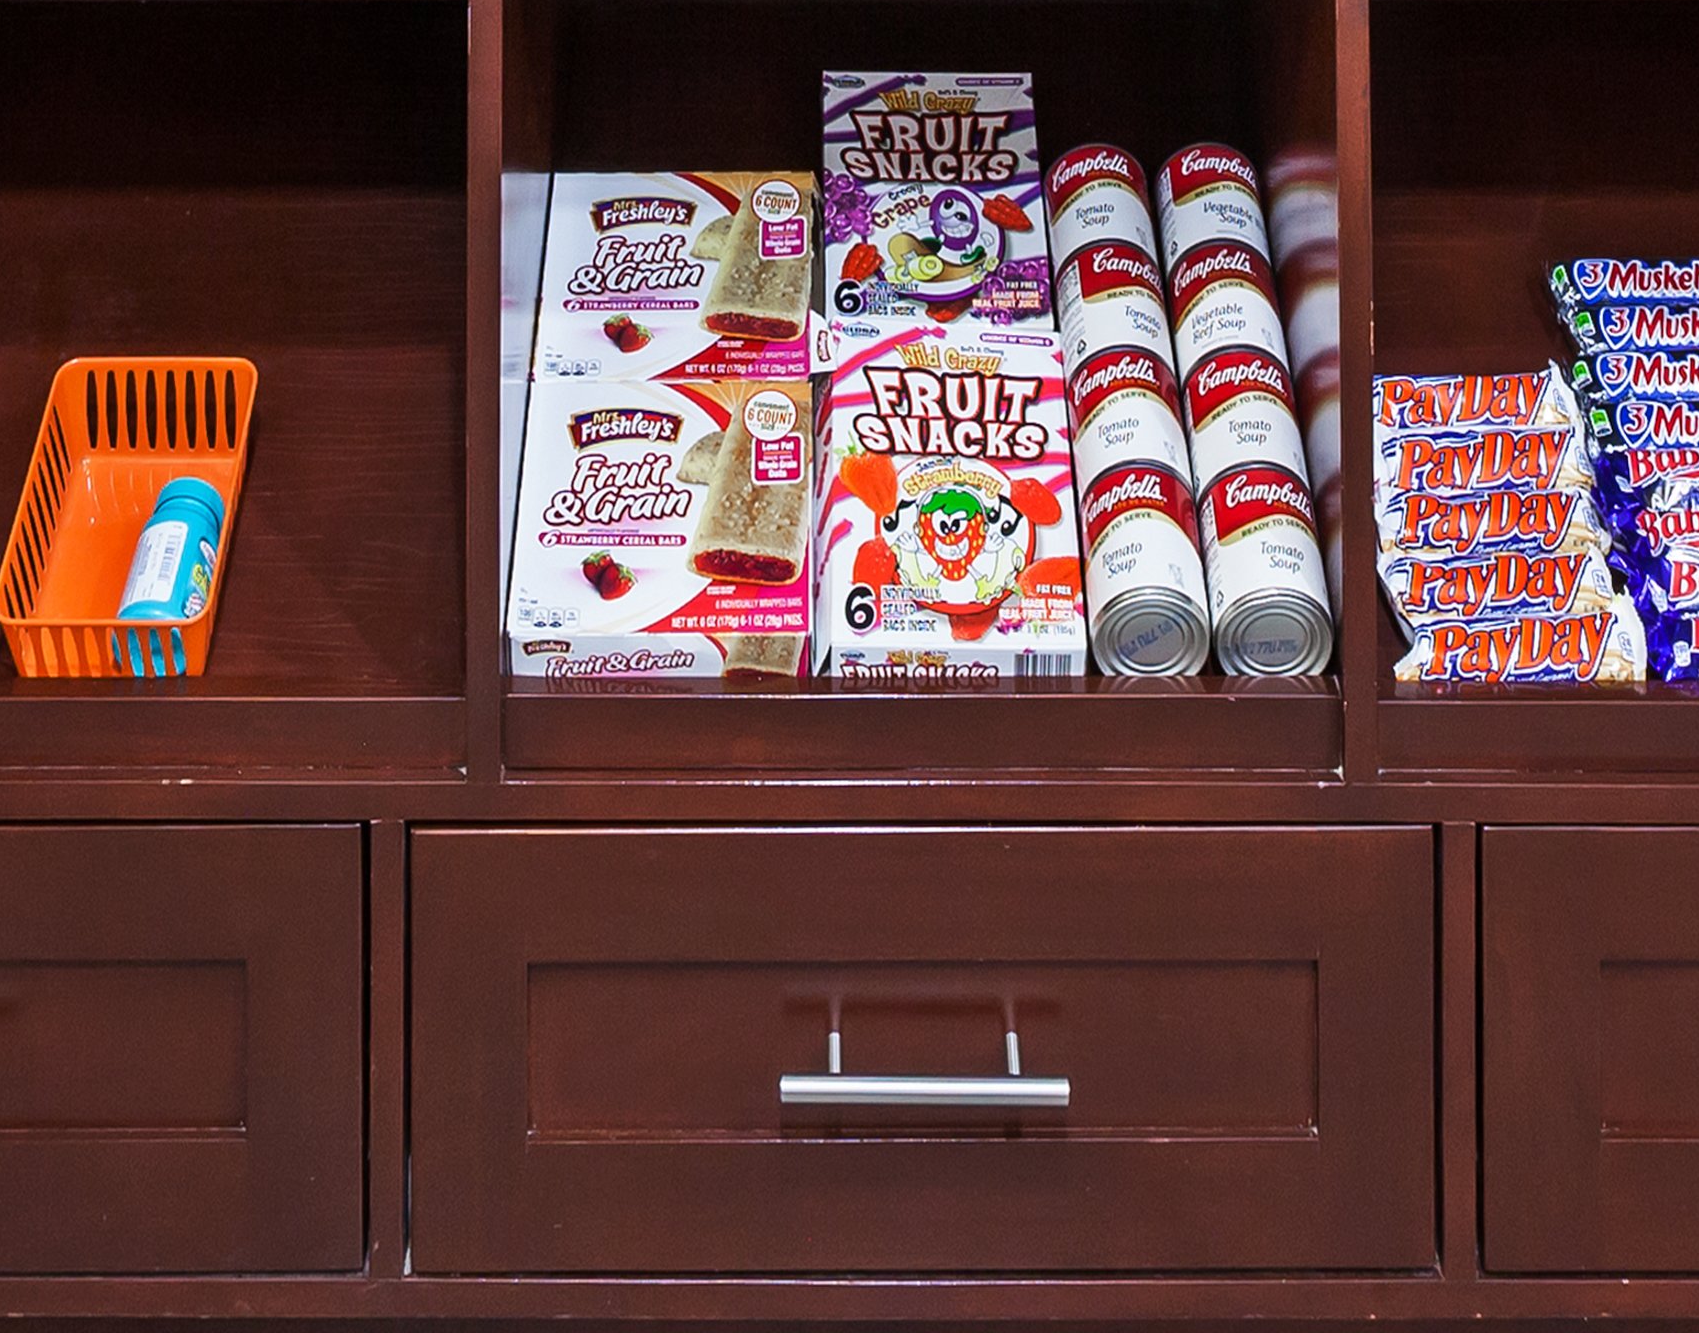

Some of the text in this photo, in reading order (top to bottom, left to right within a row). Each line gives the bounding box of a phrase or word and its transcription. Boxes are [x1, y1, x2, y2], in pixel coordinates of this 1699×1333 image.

[879, 91, 978, 113] Wild Crazy
[851, 112, 1011, 152] FRUIT
[841, 149, 1017, 182] SNACKS
[1051, 150, 1130, 193] Campbell's
[755, 195, 796, 210] 6 COUNT
[872, 194, 933, 229] Grape
[1075, 202, 1115, 221] Tomato
[1082, 215, 1110, 229] Soup
[1582, 262, 1602, 285] 3
[834, 281, 862, 315] 6
[580, 417, 675, 442] Freshley's
[762, 441, 795, 452] Low Fat
[572, 452, 673, 490] Fruit
[903, 468, 1002, 497] Strawberry
[543, 484, 692, 526] & Grain
[1225, 474, 1314, 521] Campbell's
[541, 530, 682, 547] 6 STRAWBERRY CEREAL BARS
[1241, 520, 1270, 537] READY
[1284, 518, 1312, 534] SERVE
[1260, 541, 1304, 562] Tomato
[1269, 554, 1301, 574] Soup
[882, 620, 937, 632] BAGS INSIDE
[1426, 612, 1614, 683] PayDay
